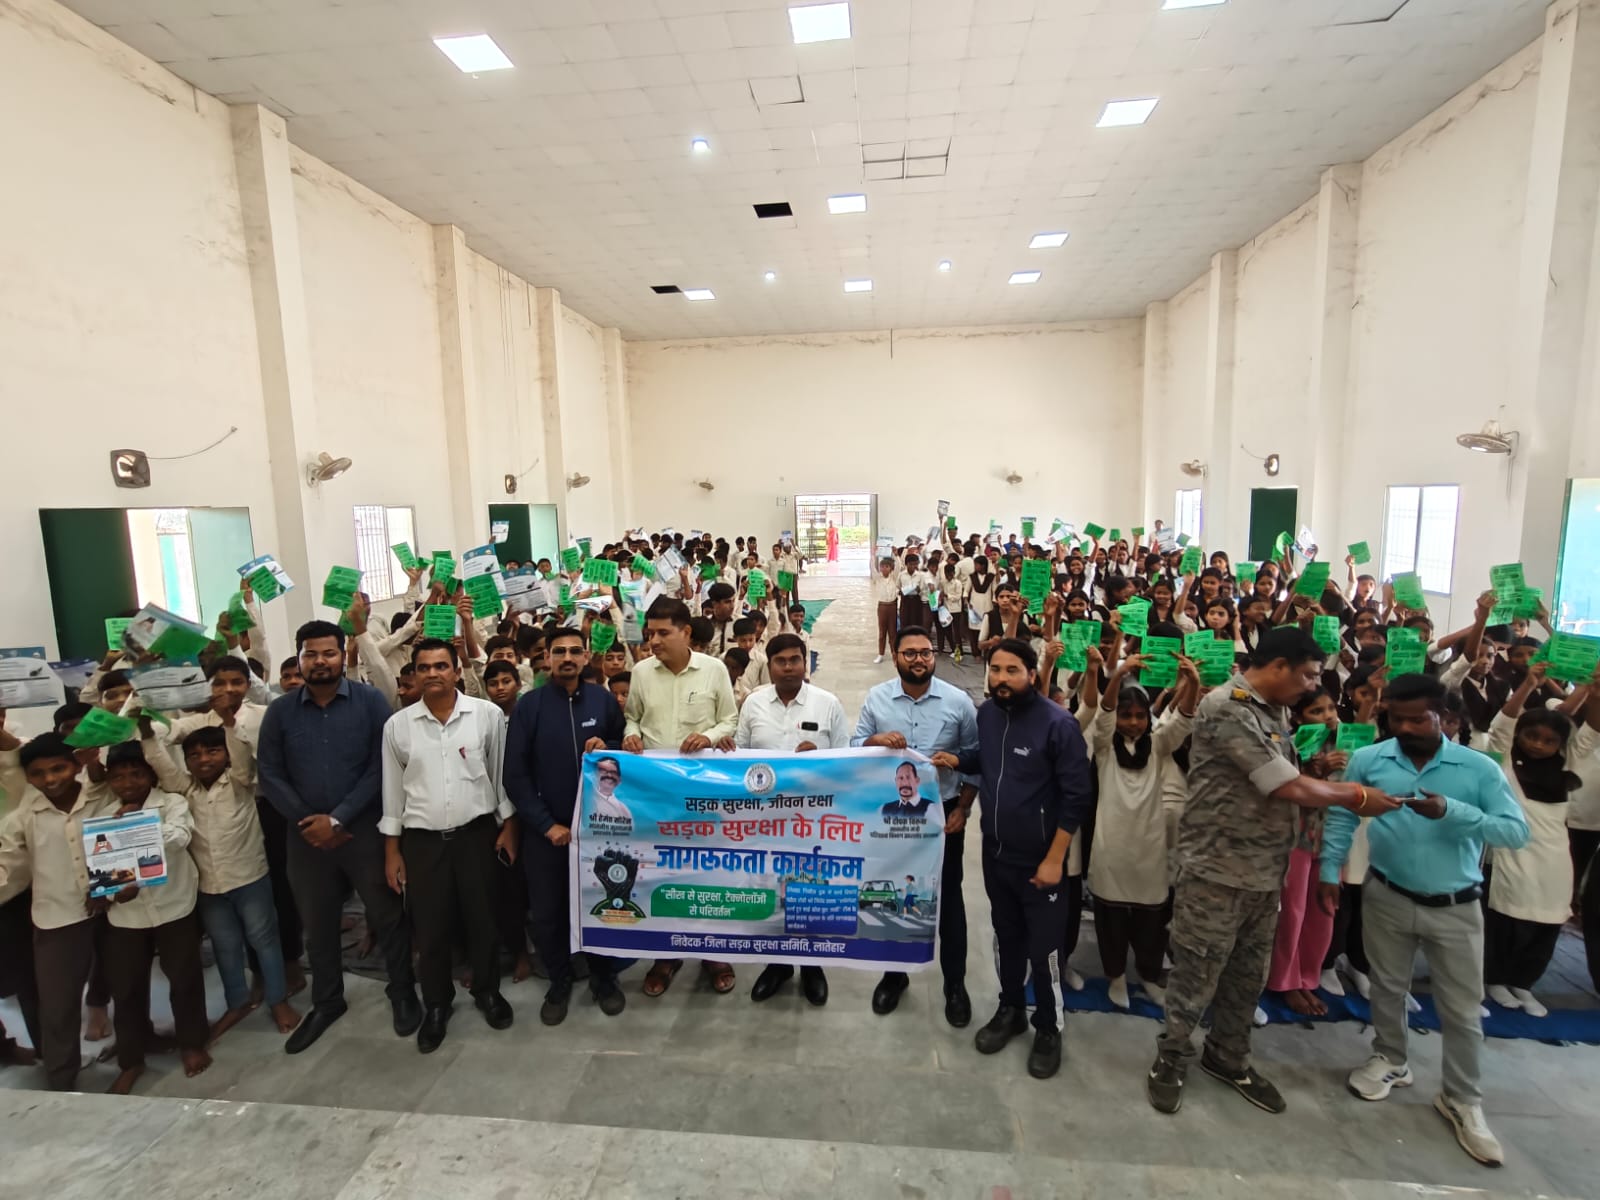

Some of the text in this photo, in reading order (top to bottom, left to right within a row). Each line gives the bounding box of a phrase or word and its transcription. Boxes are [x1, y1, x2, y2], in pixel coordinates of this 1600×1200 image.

[685, 794, 834, 813] सड़क सुरक्षा, जीवन रक्षा
[657, 813, 864, 843] सड़क सुरक्षा के लिए
[654, 845, 865, 880] जागरूकता कार्यक्रम
[687, 888, 696, 900] से
[689, 904, 697, 916] से
[728, 935, 751, 951] सड़क
[753, 939, 779, 952] सुरक्षा
[780, 938, 811, 953] समिति,
[813, 940, 846, 953] लातेहार
